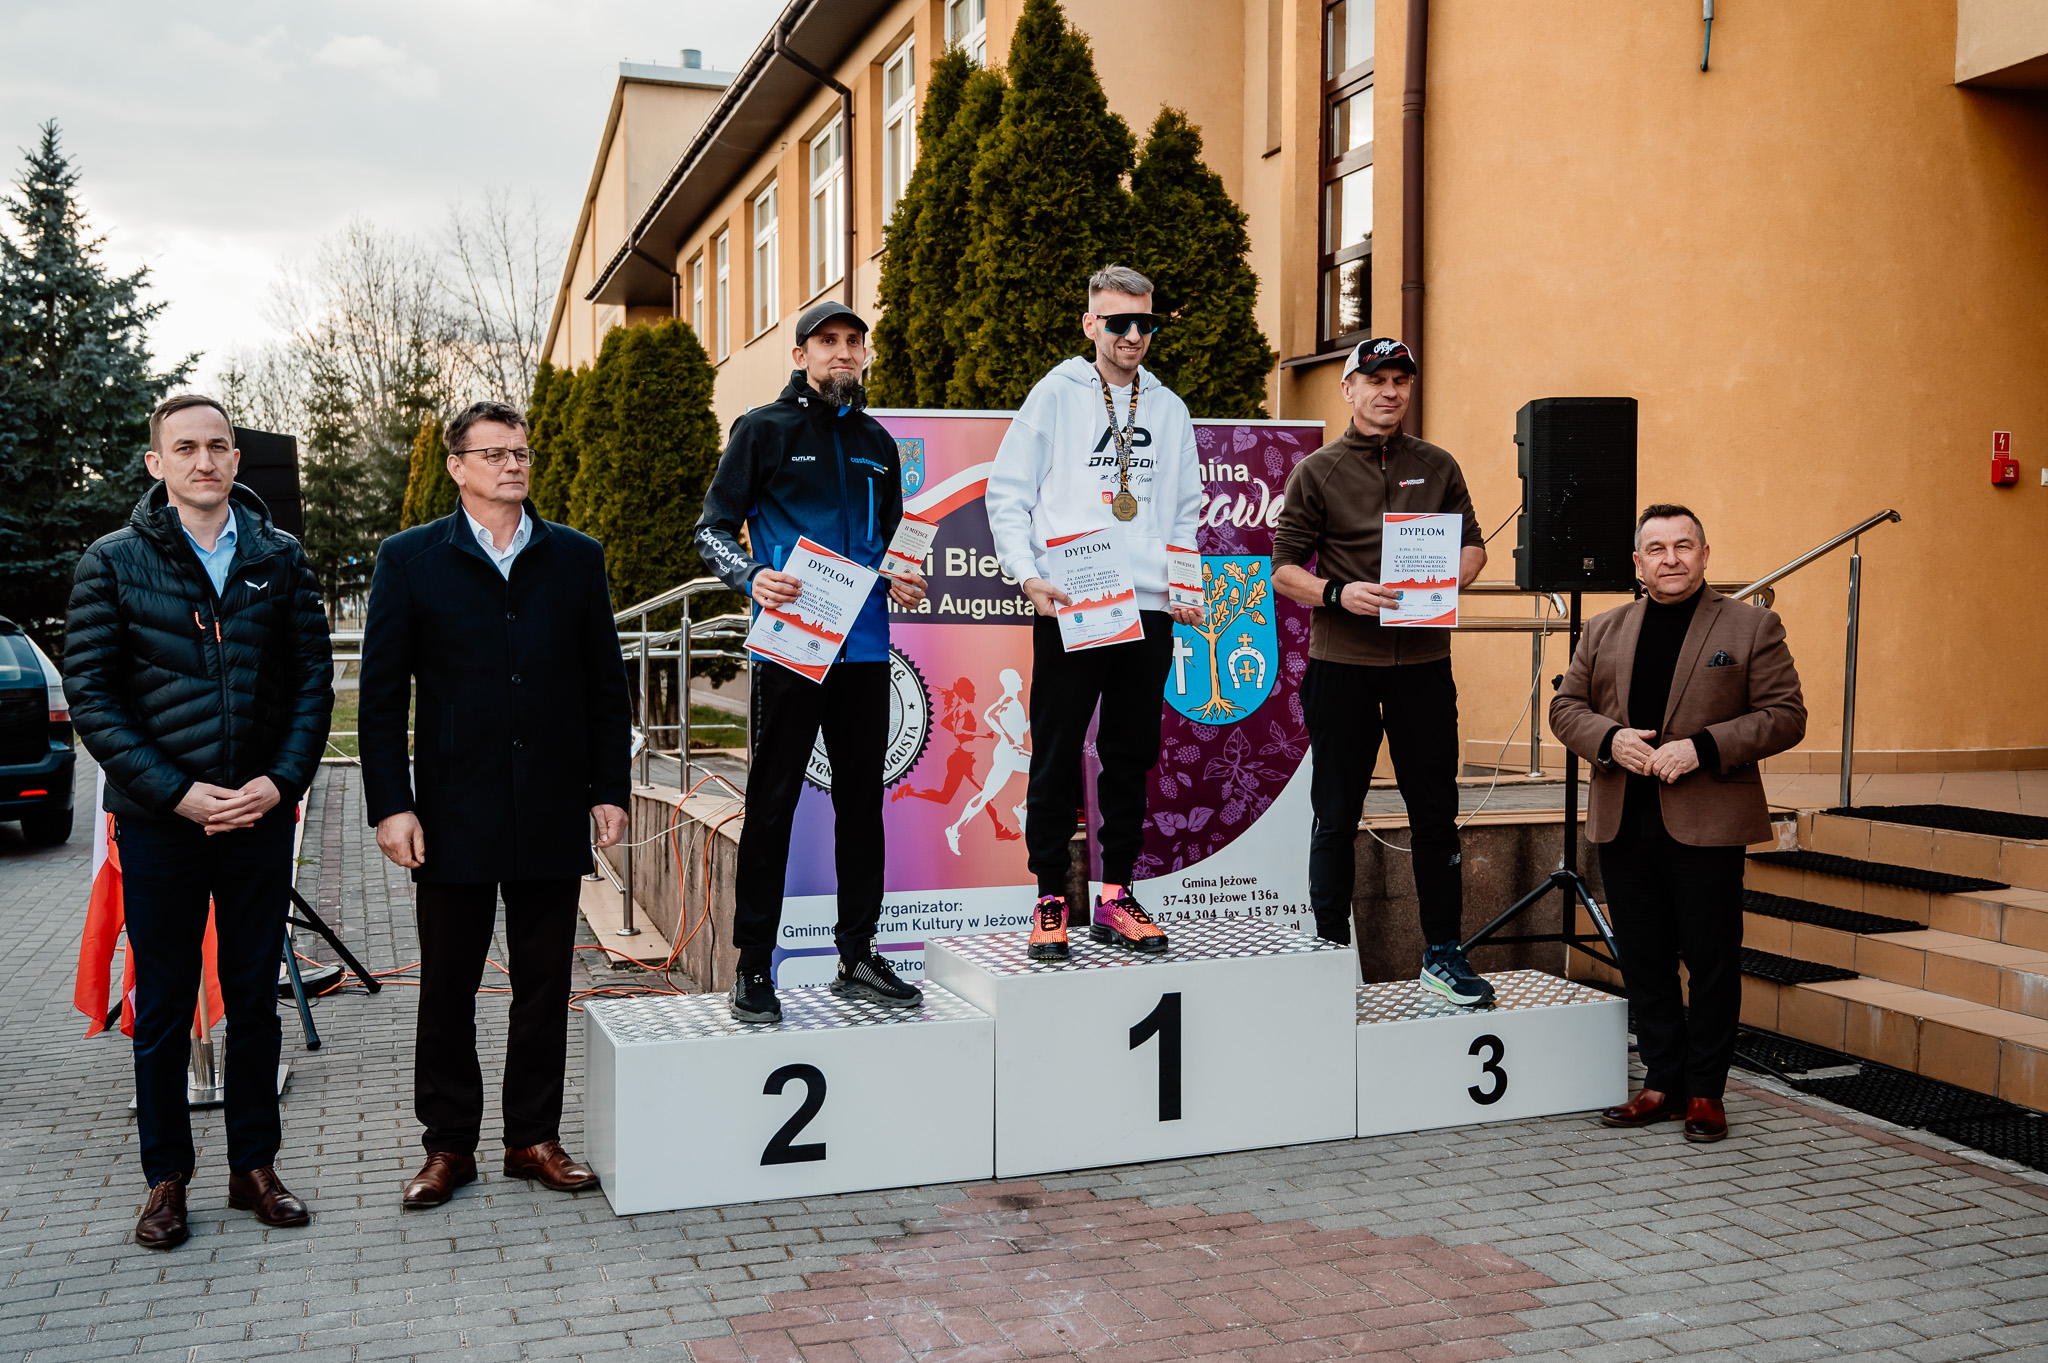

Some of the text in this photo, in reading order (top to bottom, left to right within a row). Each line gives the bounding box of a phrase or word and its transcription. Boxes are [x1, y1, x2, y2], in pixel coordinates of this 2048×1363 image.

[1400, 528, 1445, 536] DYPLOM
[1064, 542, 1111, 558] DYPLOM
[808, 559, 854, 588] DYPLOM
[938, 594, 1034, 620] Augusta
[1182, 876, 1257, 889] Gmina Jeżowe
[1163, 890, 1279, 906] 37-430 Jeżowe 136a
[1158, 912, 1172, 921] 87
[1176, 911, 1190, 920] 94
[1248, 907, 1261, 917] 15
[1265, 905, 1278, 916] 87
[1283, 904, 1296, 915] 94
[912, 917, 963, 931] Kultury
[968, 918, 979, 927] w
[1128, 992, 1182, 1122] 1
[1467, 1034, 1508, 1105] 3
[760, 1062, 828, 1166] 2
